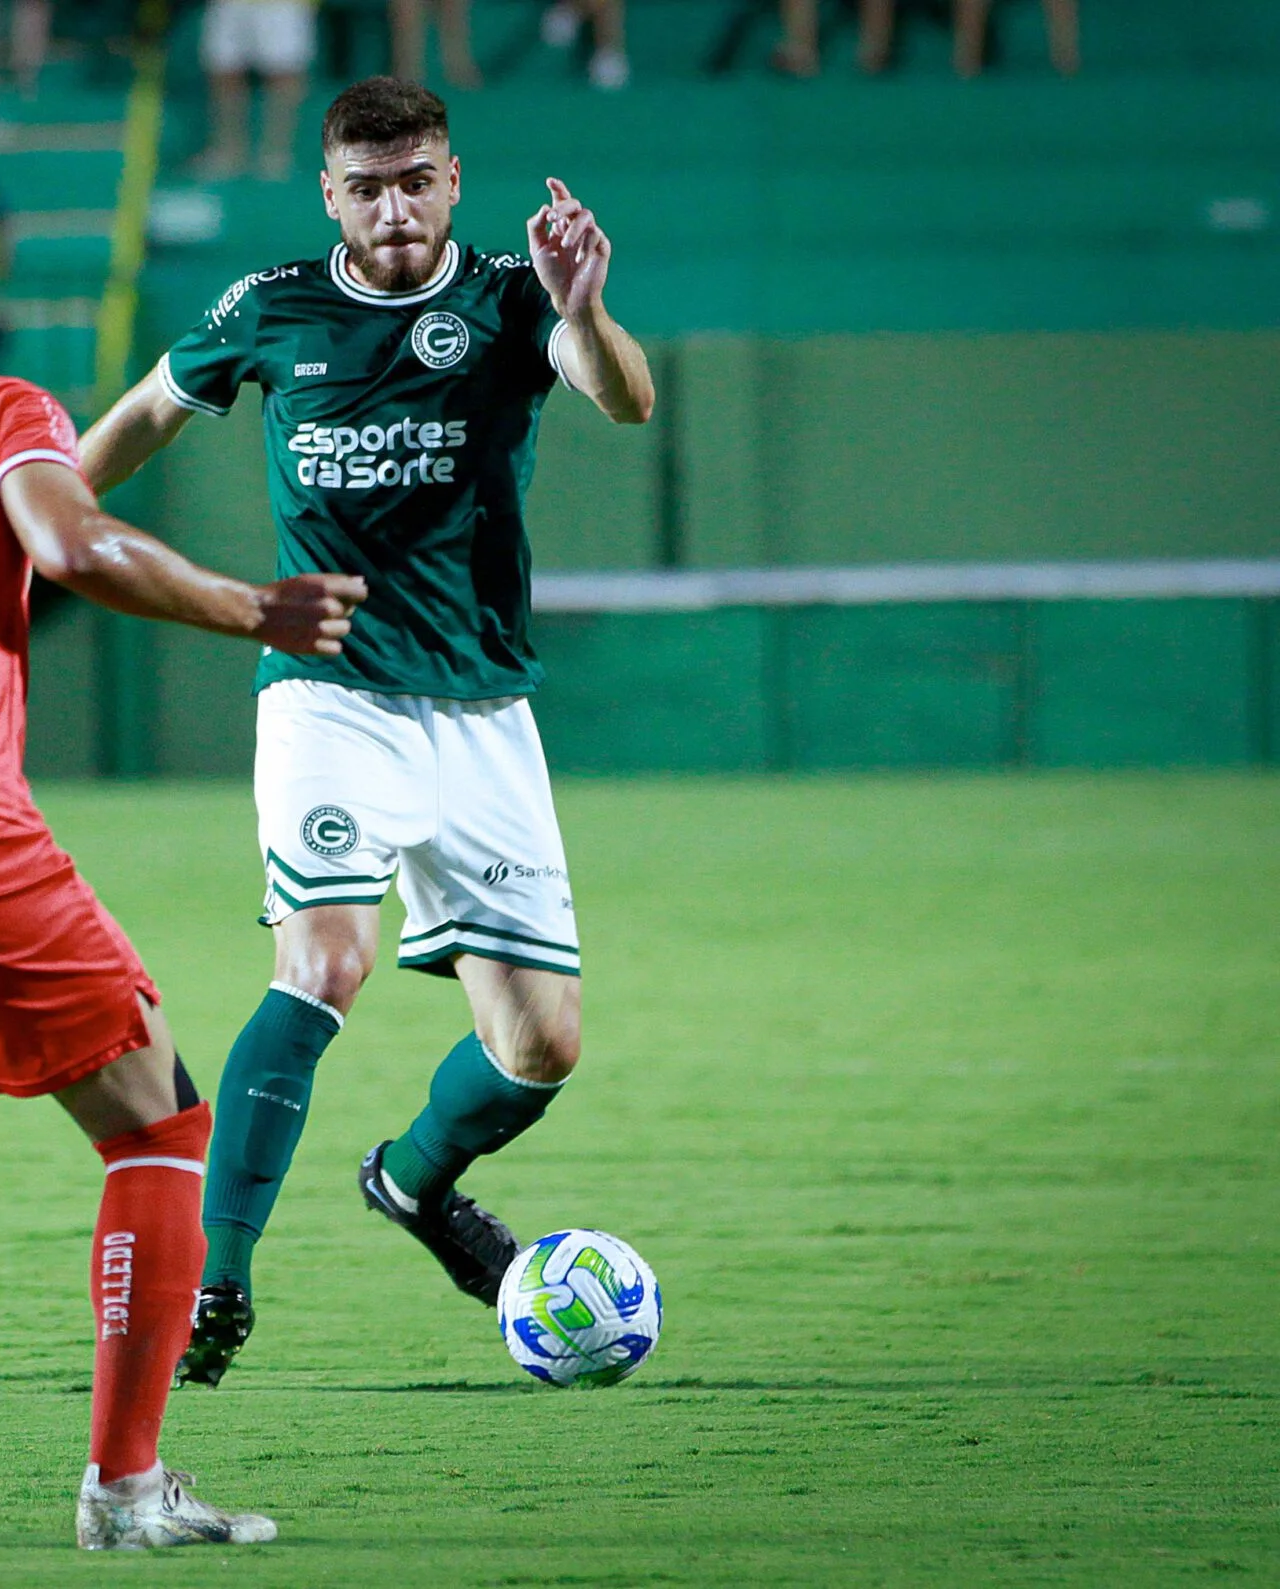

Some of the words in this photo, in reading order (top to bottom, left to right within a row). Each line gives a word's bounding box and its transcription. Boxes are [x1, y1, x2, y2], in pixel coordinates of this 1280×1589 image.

[211, 266, 300, 328] HEBRON
[294, 362, 328, 378] GREEN
[287, 415, 468, 462] Esportes
[102, 1231, 136, 1342] TOLLEDO
